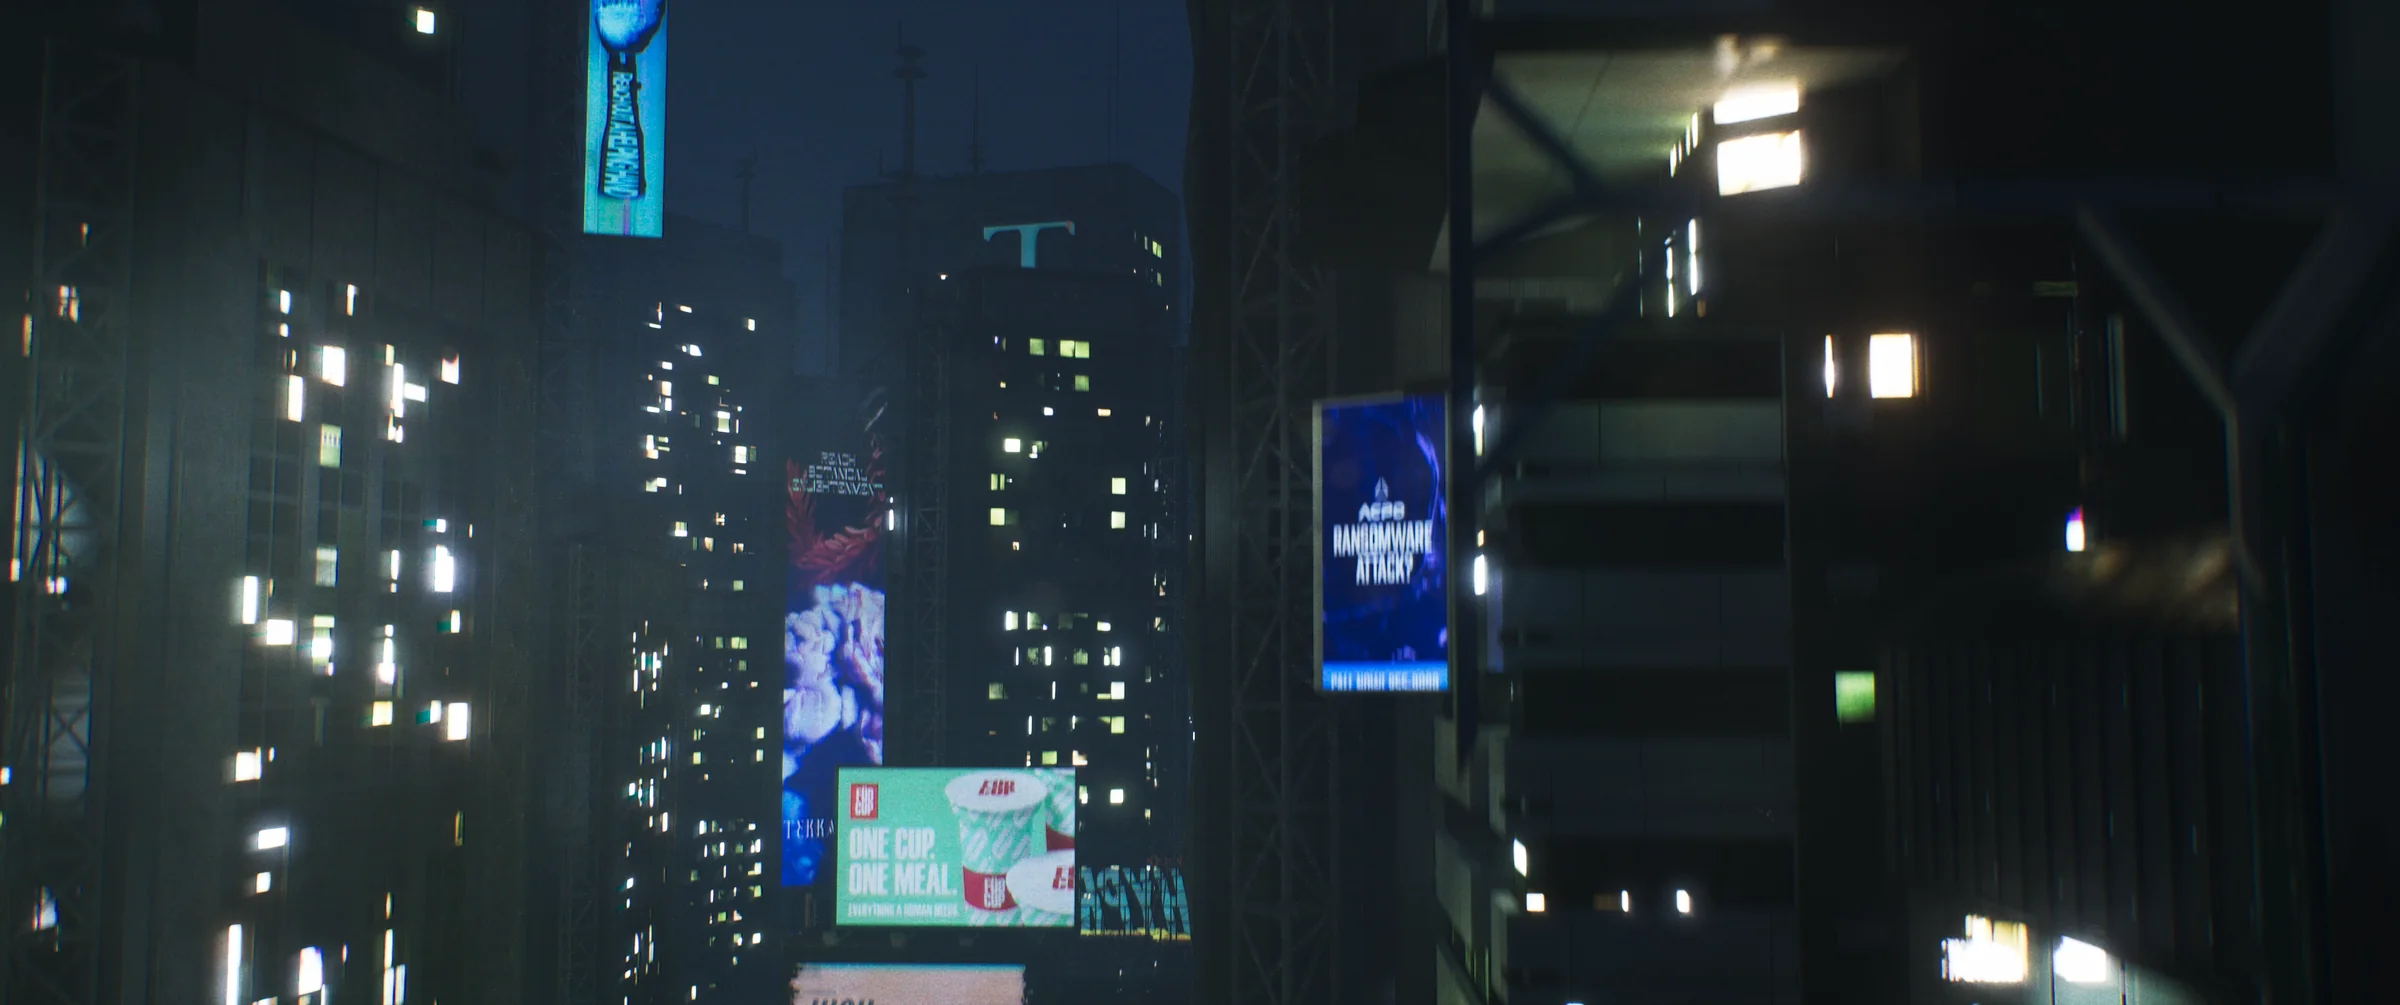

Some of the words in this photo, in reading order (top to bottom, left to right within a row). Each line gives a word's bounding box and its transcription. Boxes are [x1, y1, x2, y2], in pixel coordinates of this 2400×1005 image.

[1333, 520, 1433, 558] RANSOMWARE
[849, 827, 889, 860] ONE
[894, 826, 936, 860] CUP.
[849, 862, 889, 896] ONE
[894, 862, 958, 896] MEAL.
